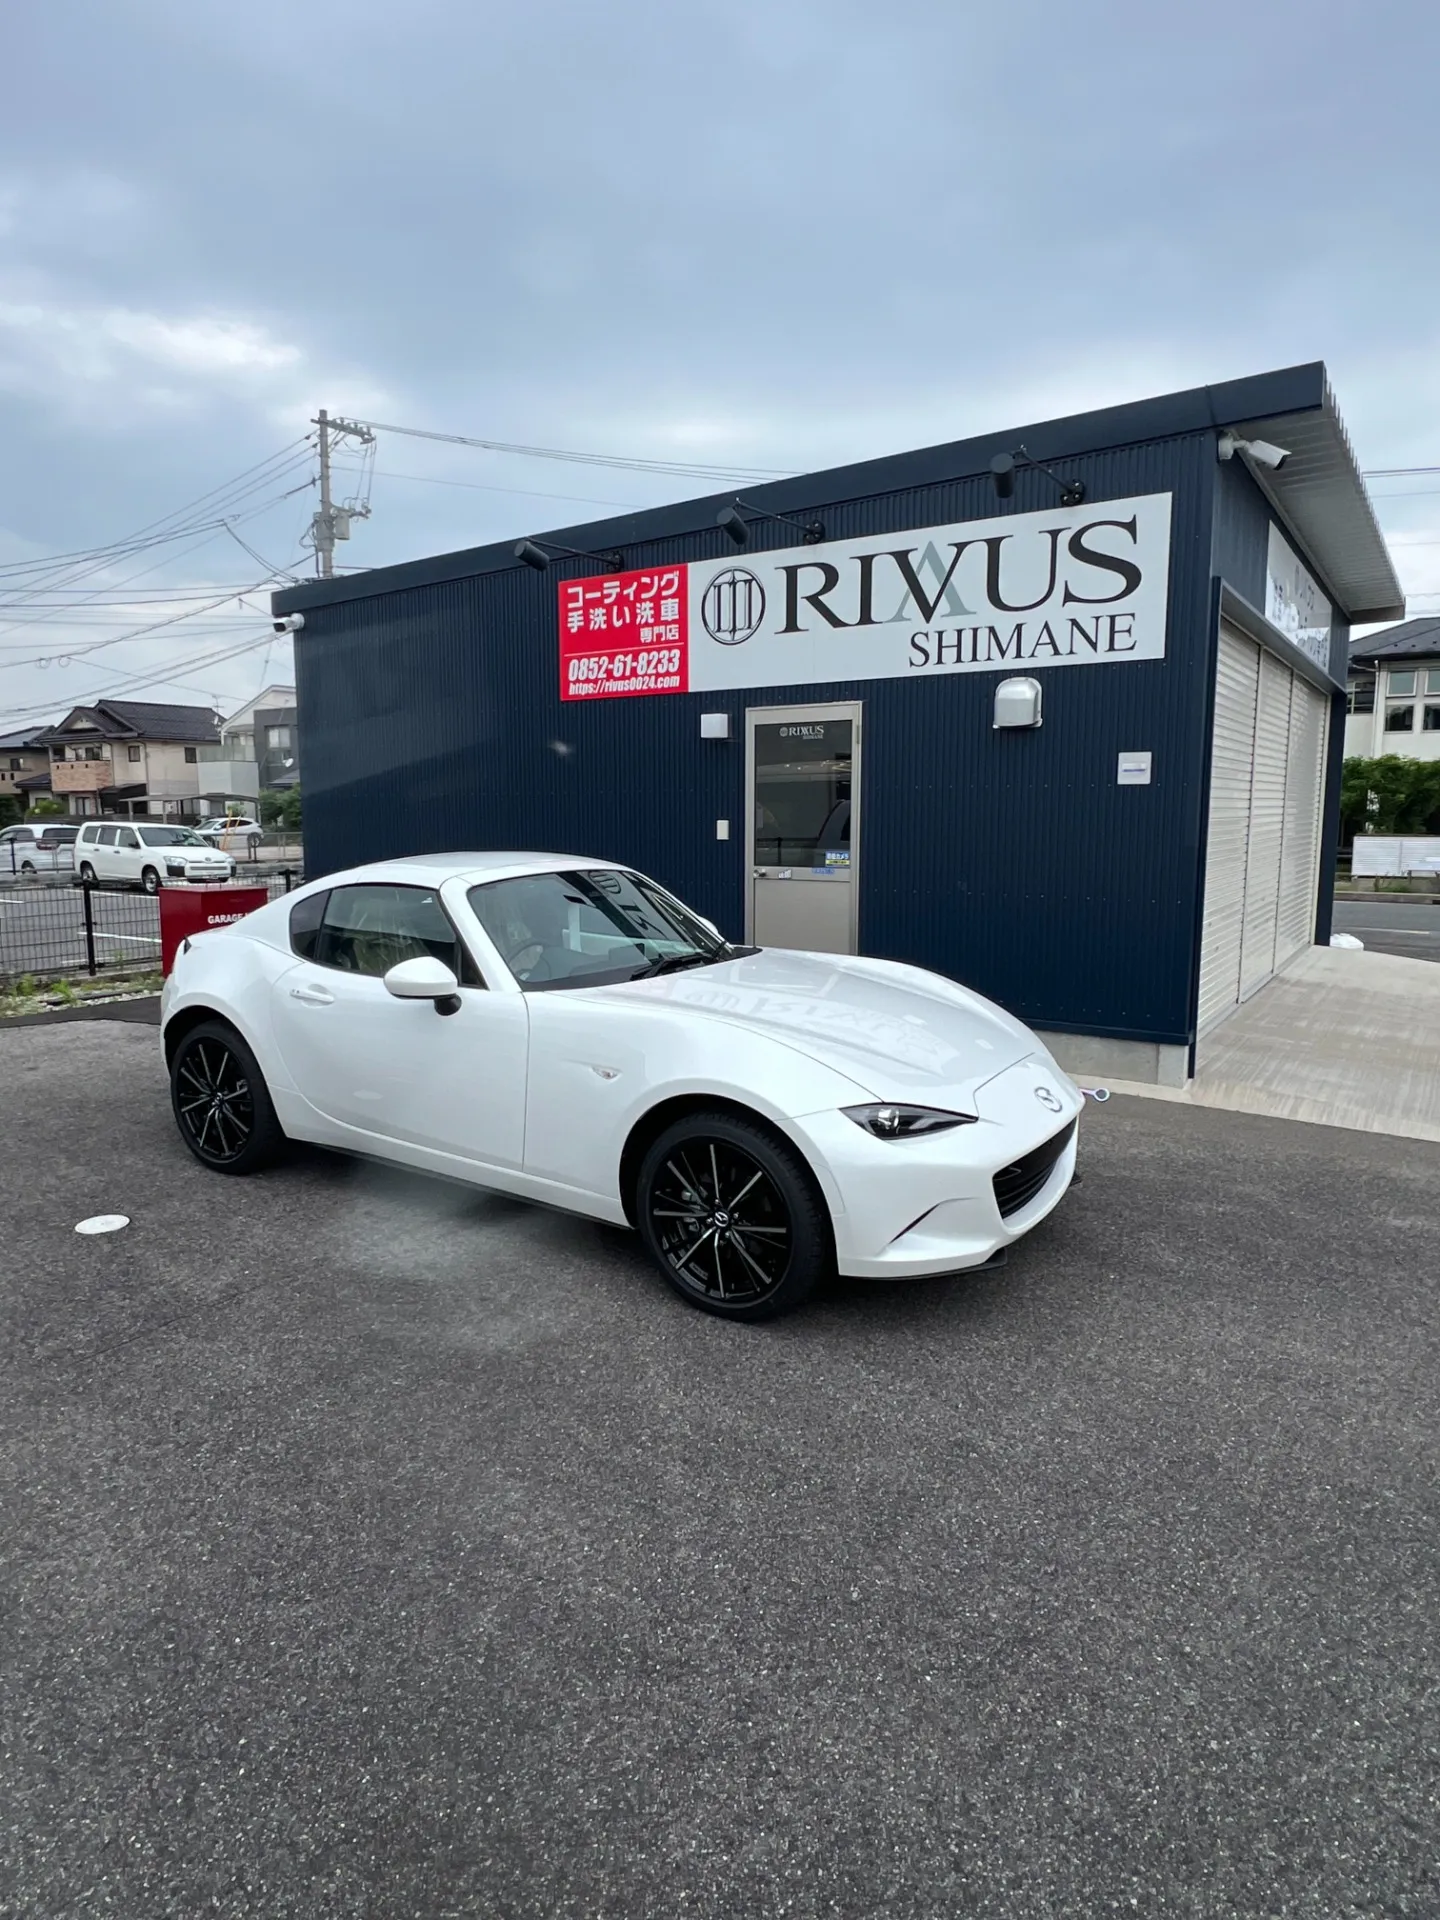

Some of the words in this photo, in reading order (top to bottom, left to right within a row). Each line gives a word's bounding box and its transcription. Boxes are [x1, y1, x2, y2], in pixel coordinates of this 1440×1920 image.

[567, 571, 679, 609] コーティング
[774, 514, 1142, 635] RIVUS
[567, 598, 679, 633] 手洗い洗車
[640, 624, 679, 643] 専門店
[909, 612, 1138, 668] SHIMANE
[568, 649, 681, 681] 0852-61-8233
[568, 675, 680, 696] https://rivus0024.com
[207, 913, 243, 924] GARAGE
